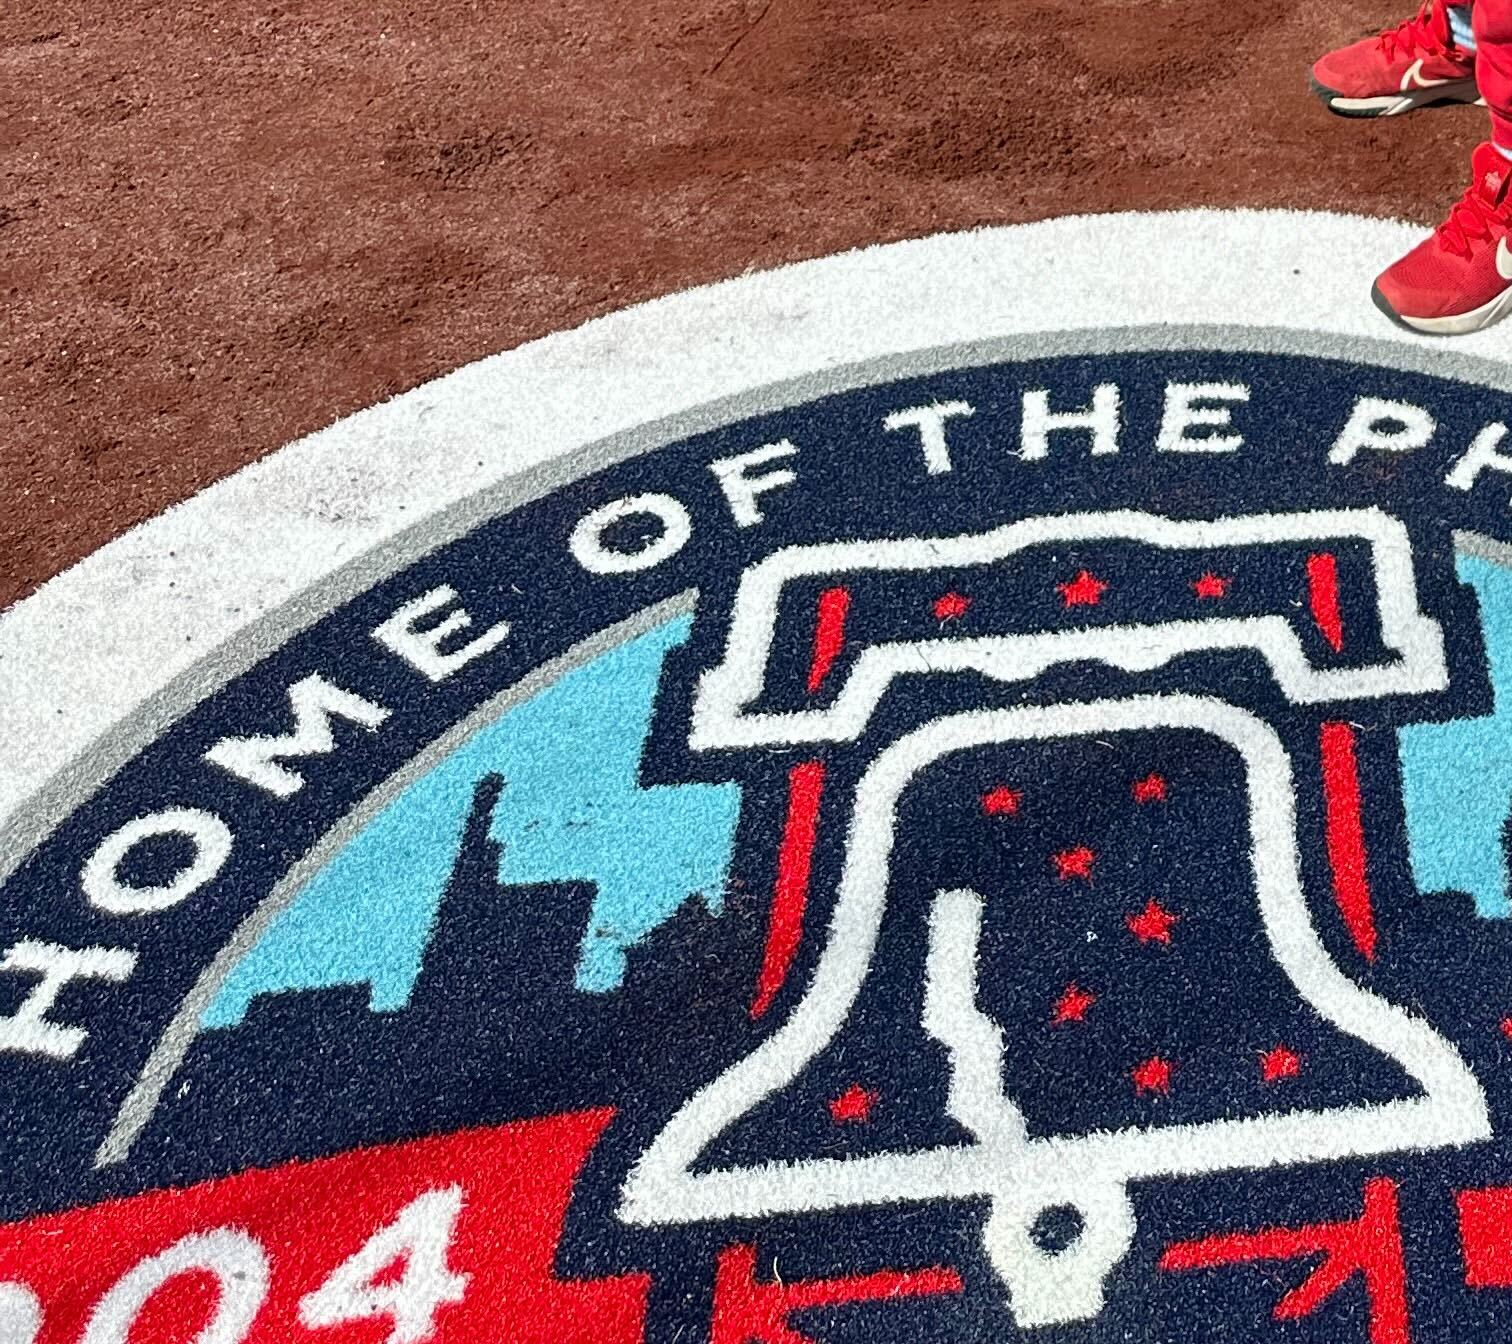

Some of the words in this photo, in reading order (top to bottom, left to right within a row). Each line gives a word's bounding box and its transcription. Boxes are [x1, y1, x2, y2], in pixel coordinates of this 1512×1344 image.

[0, 584, 512, 1061] HOME
[568, 437, 798, 576] OF
[885, 381, 1249, 474] THE
